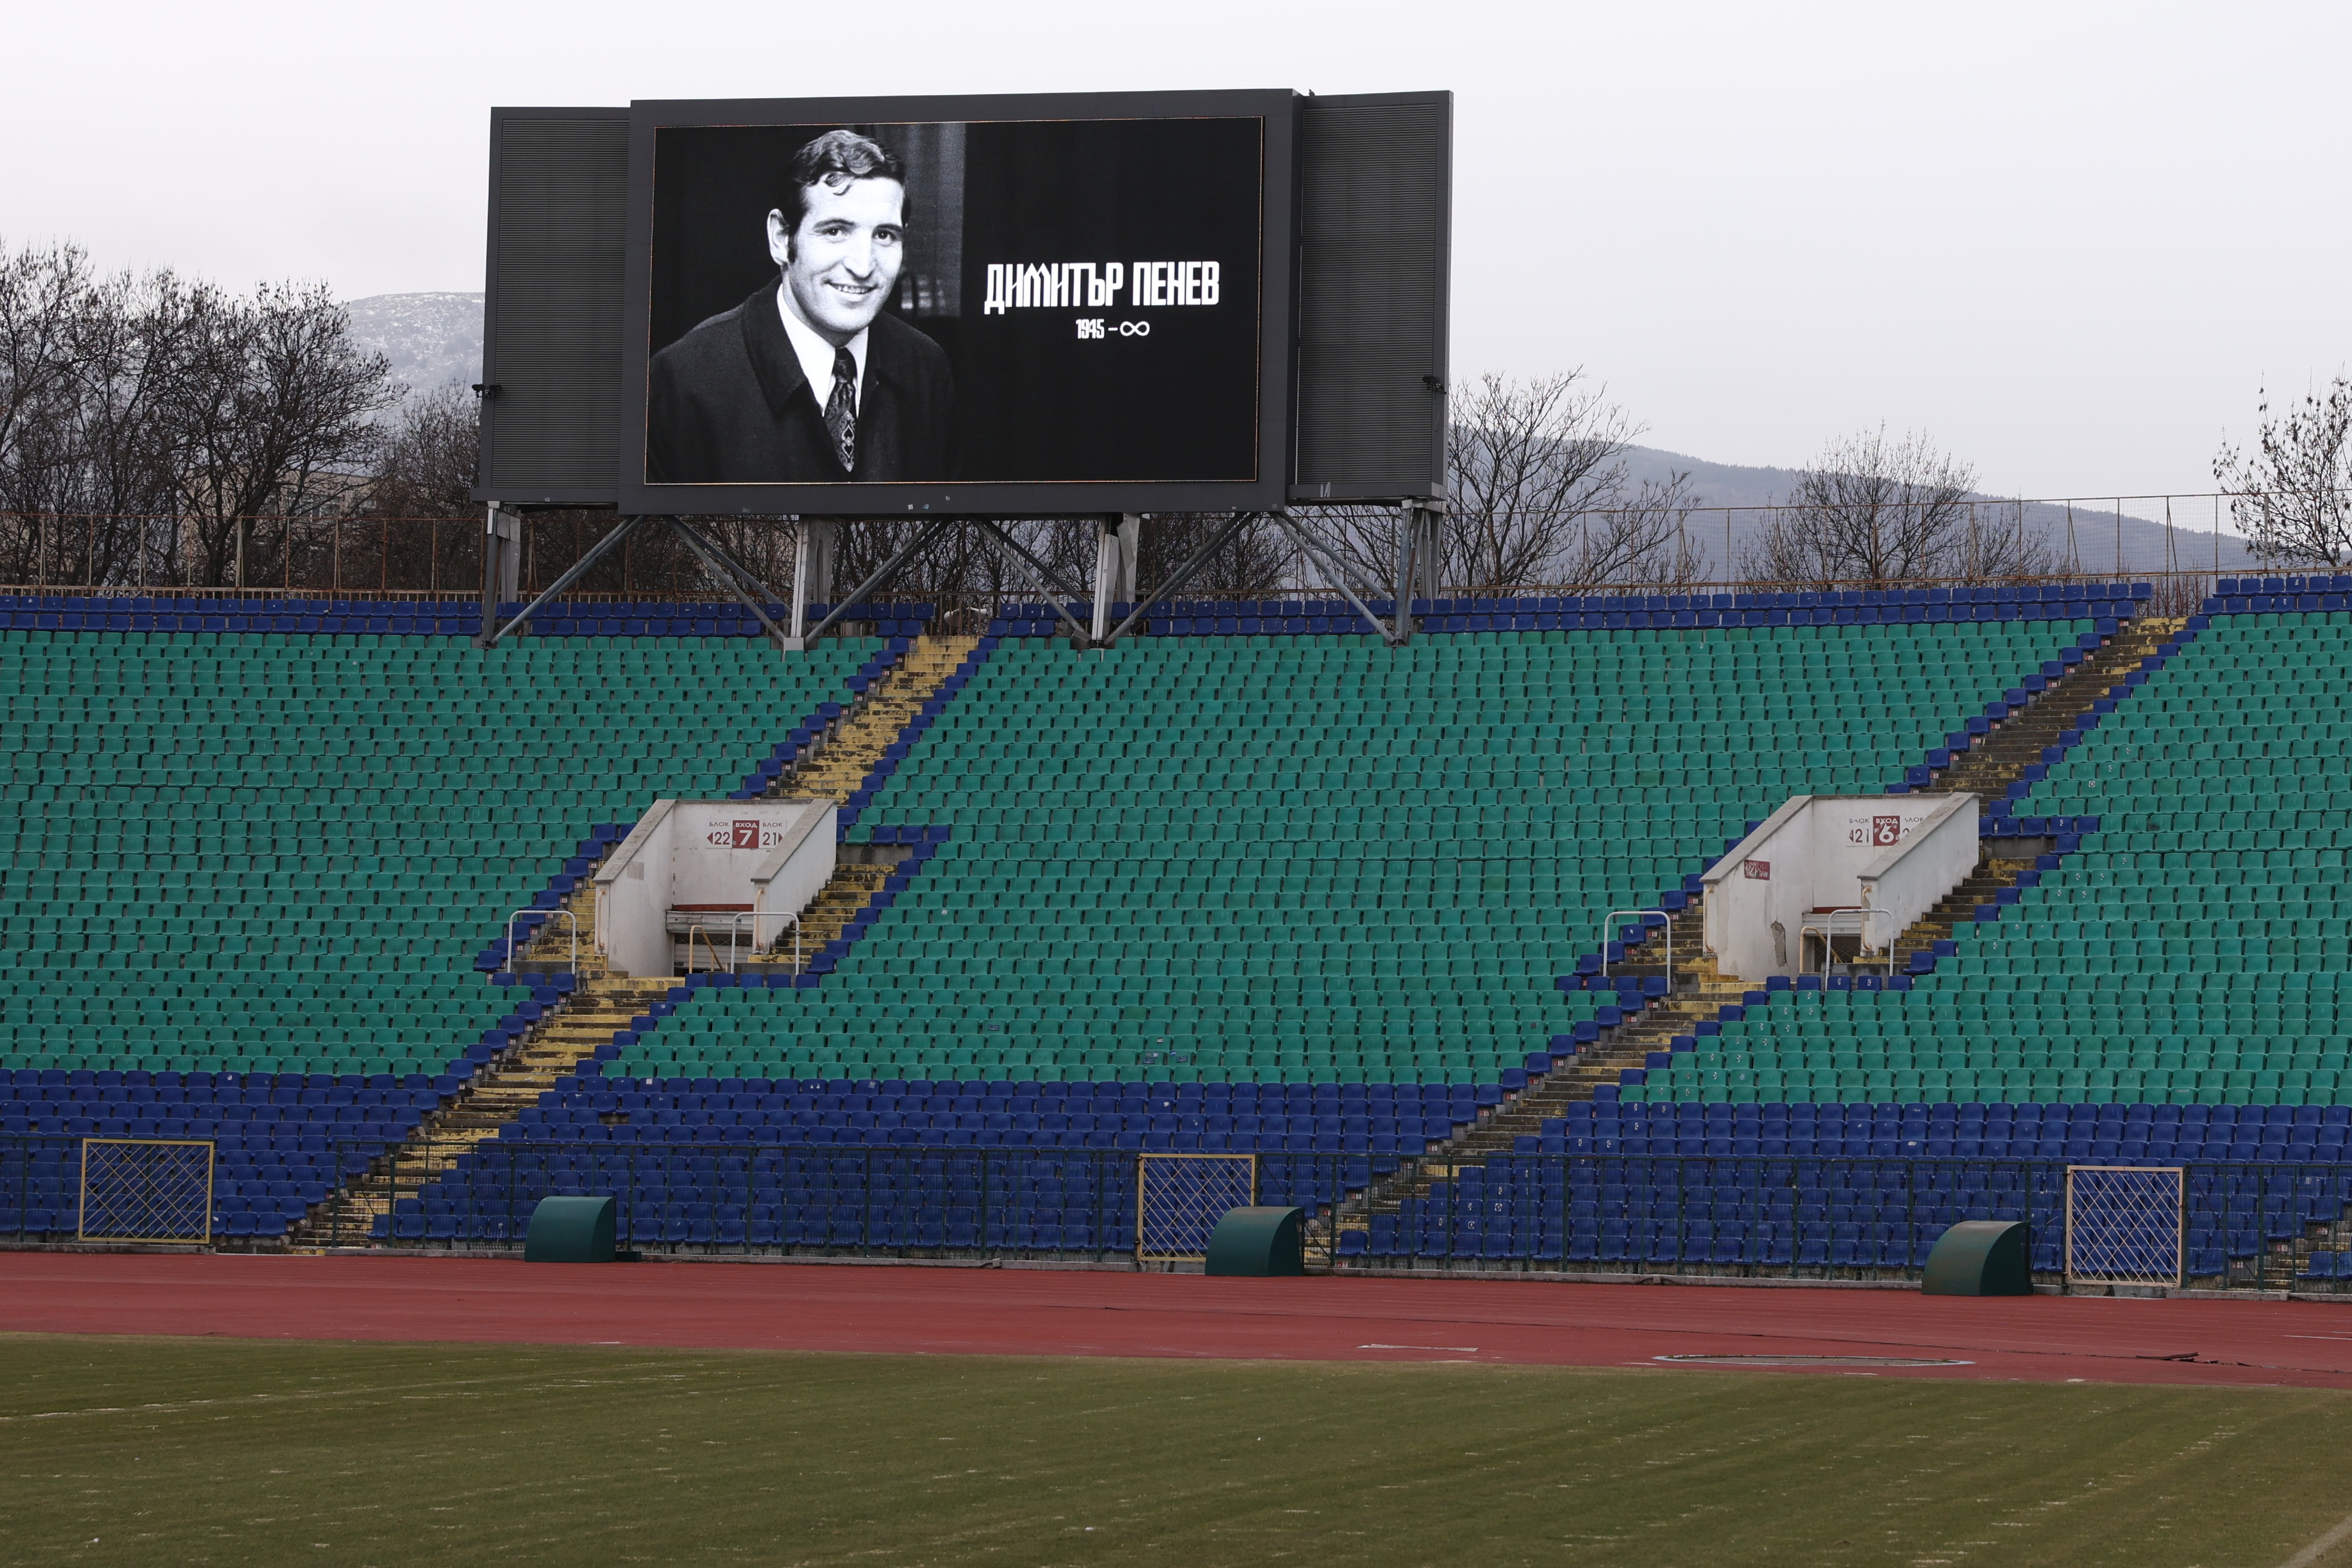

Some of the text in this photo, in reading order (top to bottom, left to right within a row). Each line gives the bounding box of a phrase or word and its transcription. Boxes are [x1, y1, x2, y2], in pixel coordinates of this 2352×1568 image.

[984, 261, 1220, 315] ДИМИТЪР ПЕНЕВ
[1076, 319, 1105, 339] 1945
[714, 831, 730, 845] 22
[739, 829, 753, 846] 7
[763, 832, 777, 846] 21
[1879, 823, 1894, 843] 6
